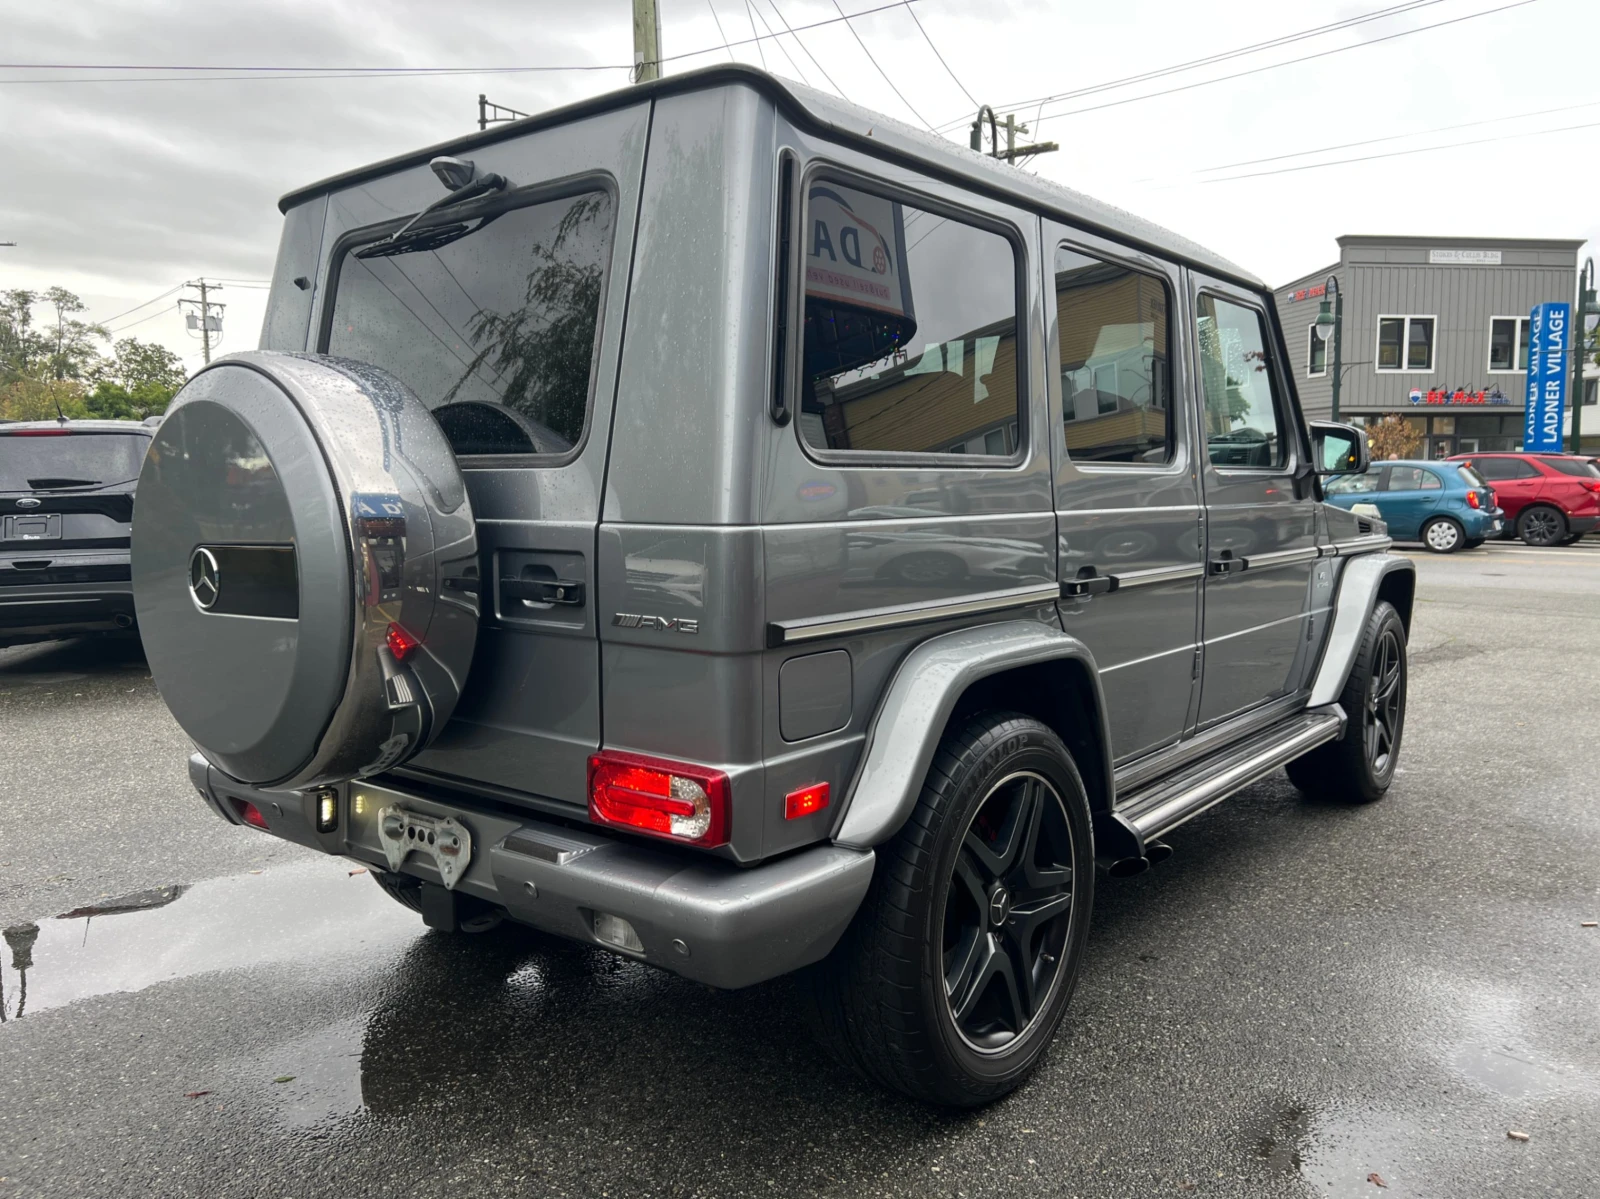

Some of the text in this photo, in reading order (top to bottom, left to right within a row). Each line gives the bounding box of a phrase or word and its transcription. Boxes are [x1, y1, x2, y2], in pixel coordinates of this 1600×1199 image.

[1546, 309, 1565, 375] VILLAGE
[1527, 312, 1541, 443] LADNER VILLAGE
[1543, 380, 1561, 443] LADNER
